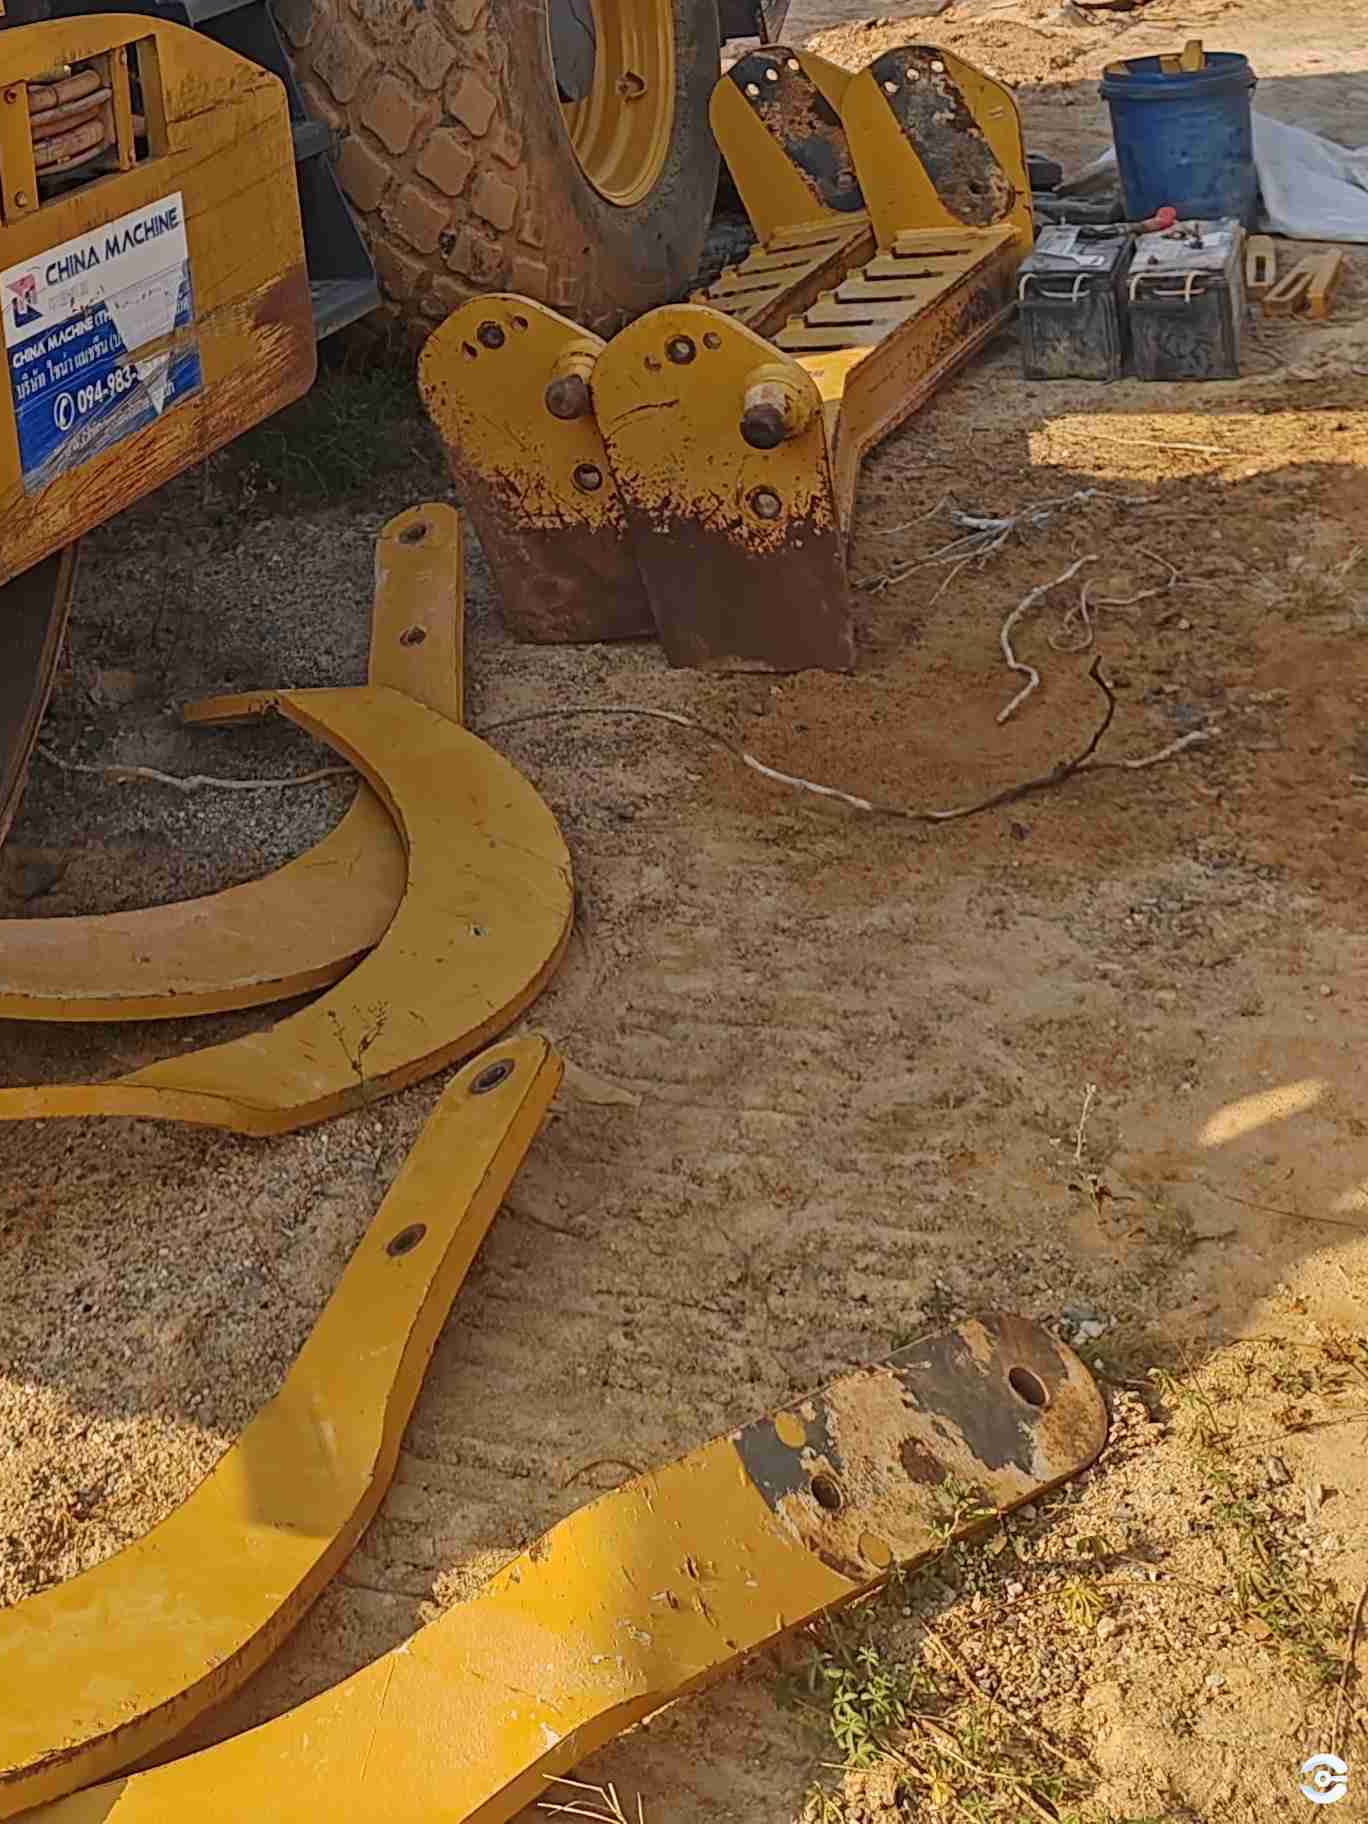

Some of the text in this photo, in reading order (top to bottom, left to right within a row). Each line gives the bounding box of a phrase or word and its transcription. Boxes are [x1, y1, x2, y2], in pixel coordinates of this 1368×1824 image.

[45, 207, 180, 286] CHINA MACHINE
[12, 342, 49, 368] CHINA
[47, 318, 95, 351] MACHINE
